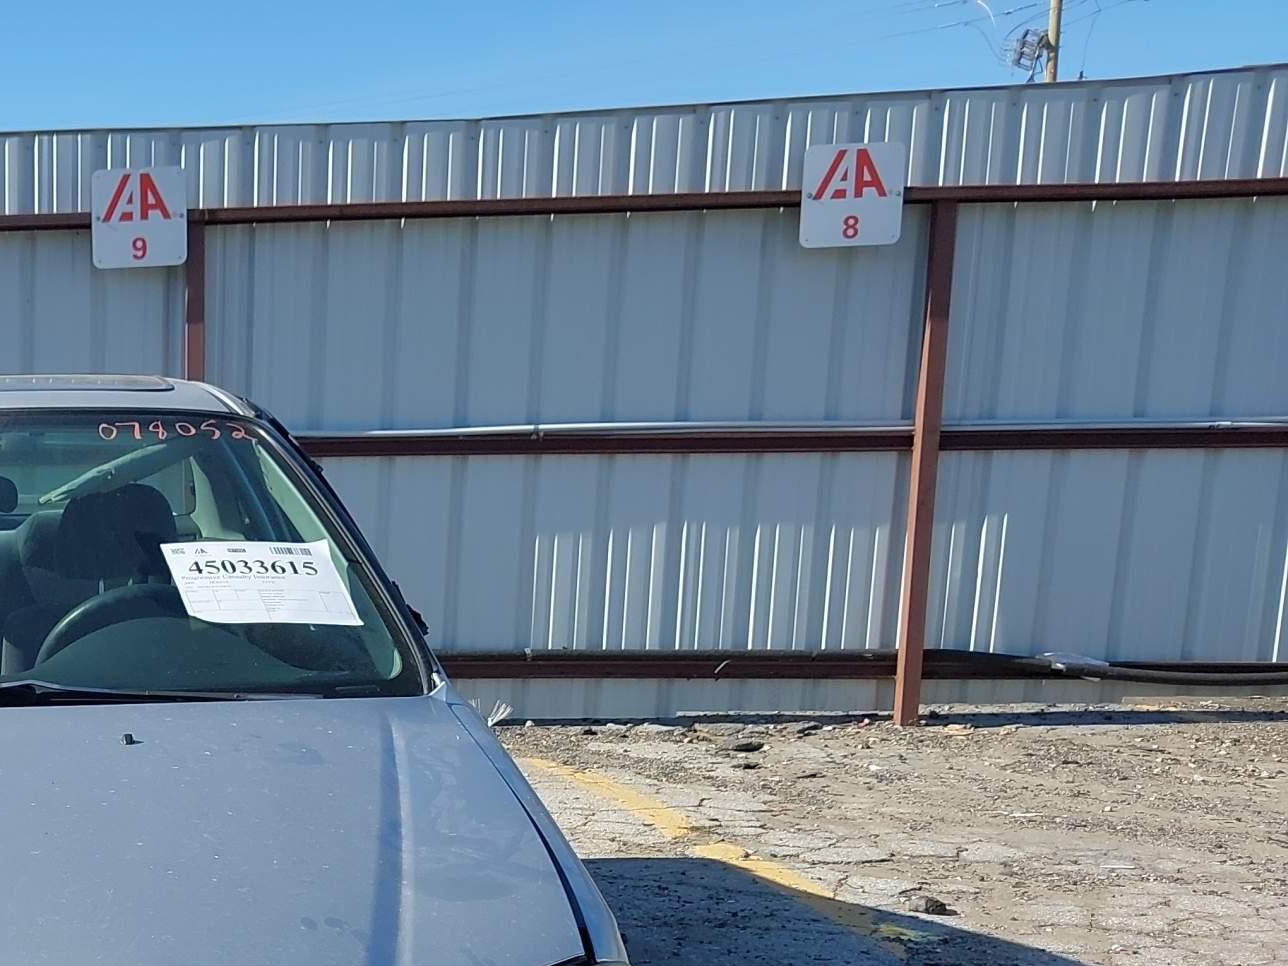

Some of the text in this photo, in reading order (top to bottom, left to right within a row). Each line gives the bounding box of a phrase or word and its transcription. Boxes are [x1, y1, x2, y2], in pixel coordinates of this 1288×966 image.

[842, 215, 859, 239] 8
[132, 237, 147, 260] 9
[98, 420, 255, 440] 078052
[188, 559, 318, 576] 45033615
